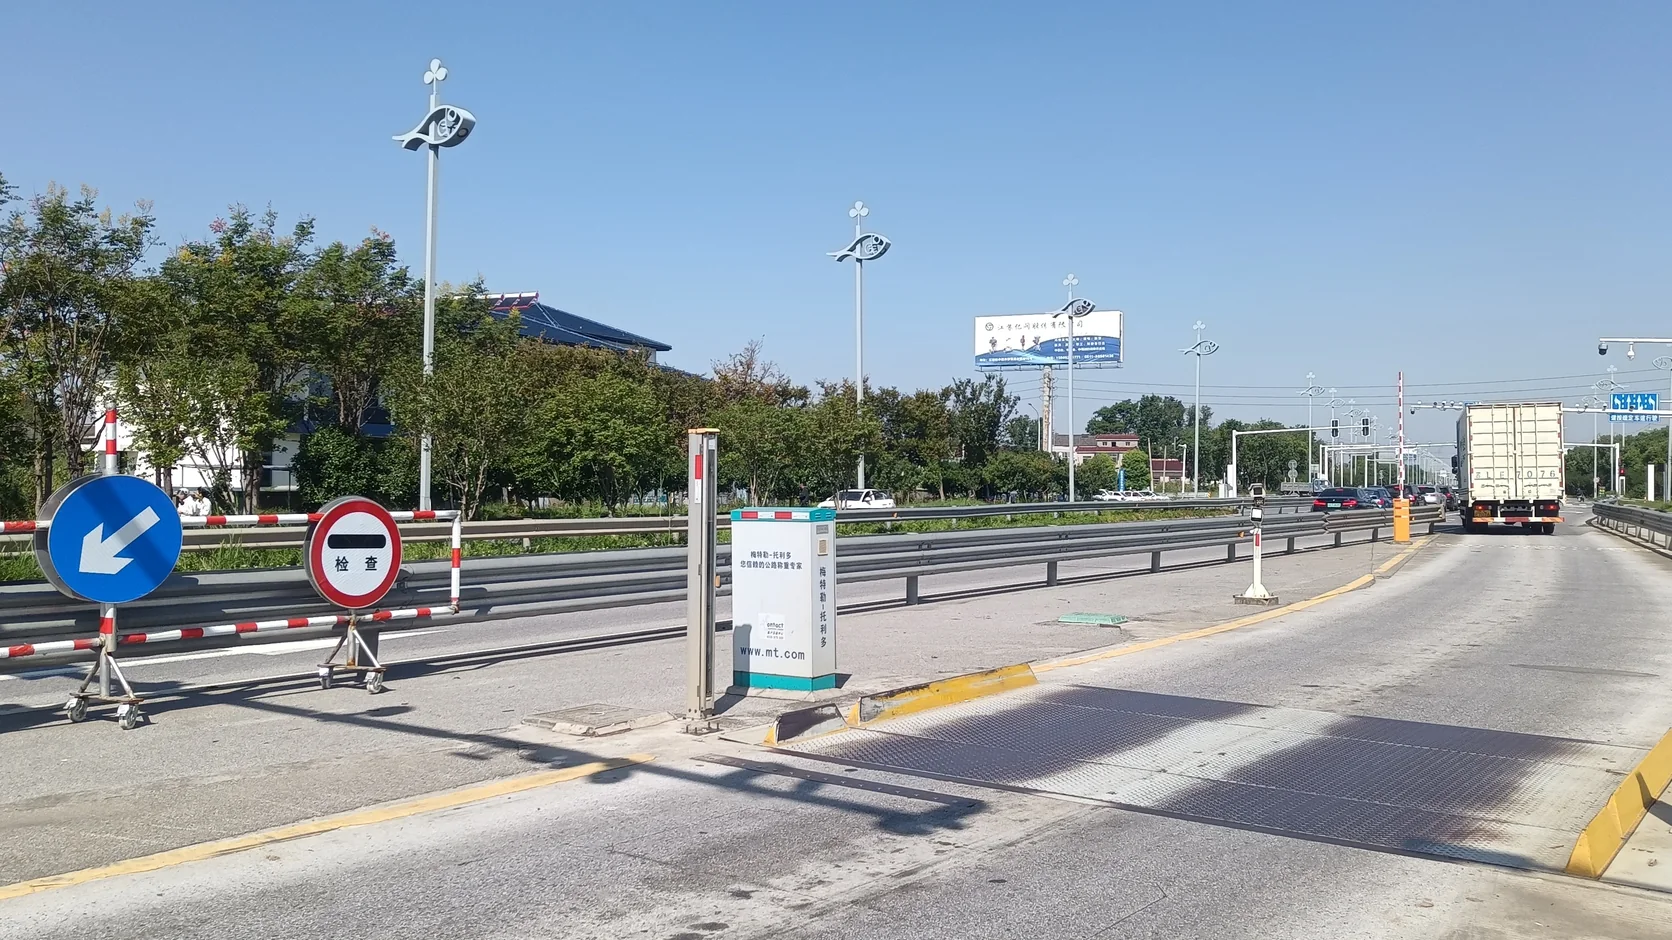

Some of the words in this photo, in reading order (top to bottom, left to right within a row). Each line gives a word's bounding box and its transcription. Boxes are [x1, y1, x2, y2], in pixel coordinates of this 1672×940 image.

[750, 551, 792, 559] 梅特勒-托利多
[335, 555, 378, 572] 检查
[740, 560, 803, 570] 您信赖的公路称重专家
[819, 566, 827, 648] 梅特勒-托利多
[740, 646, 805, 660] www.mt.com
